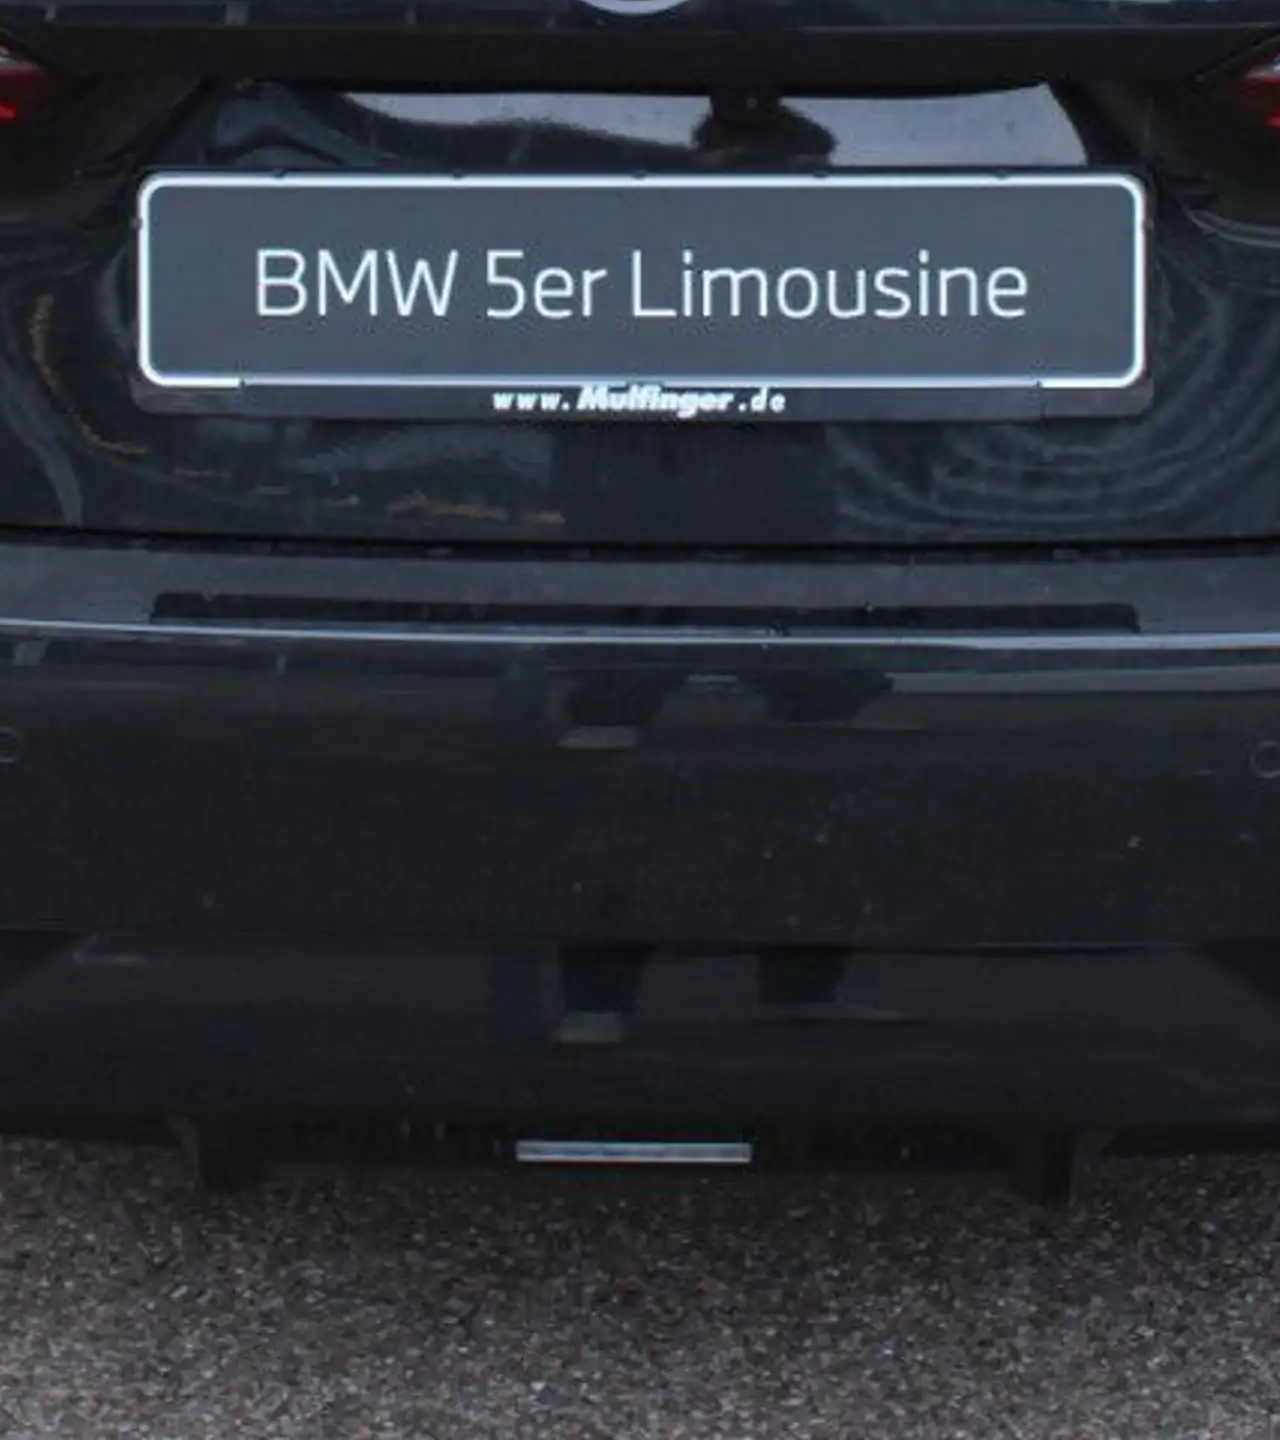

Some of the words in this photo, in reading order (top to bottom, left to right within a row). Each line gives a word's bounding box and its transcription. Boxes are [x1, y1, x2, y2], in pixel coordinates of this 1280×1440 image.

[255, 248, 459, 318] BMW
[485, 248, 608, 319] 5er
[630, 248, 1029, 319] Limousine
